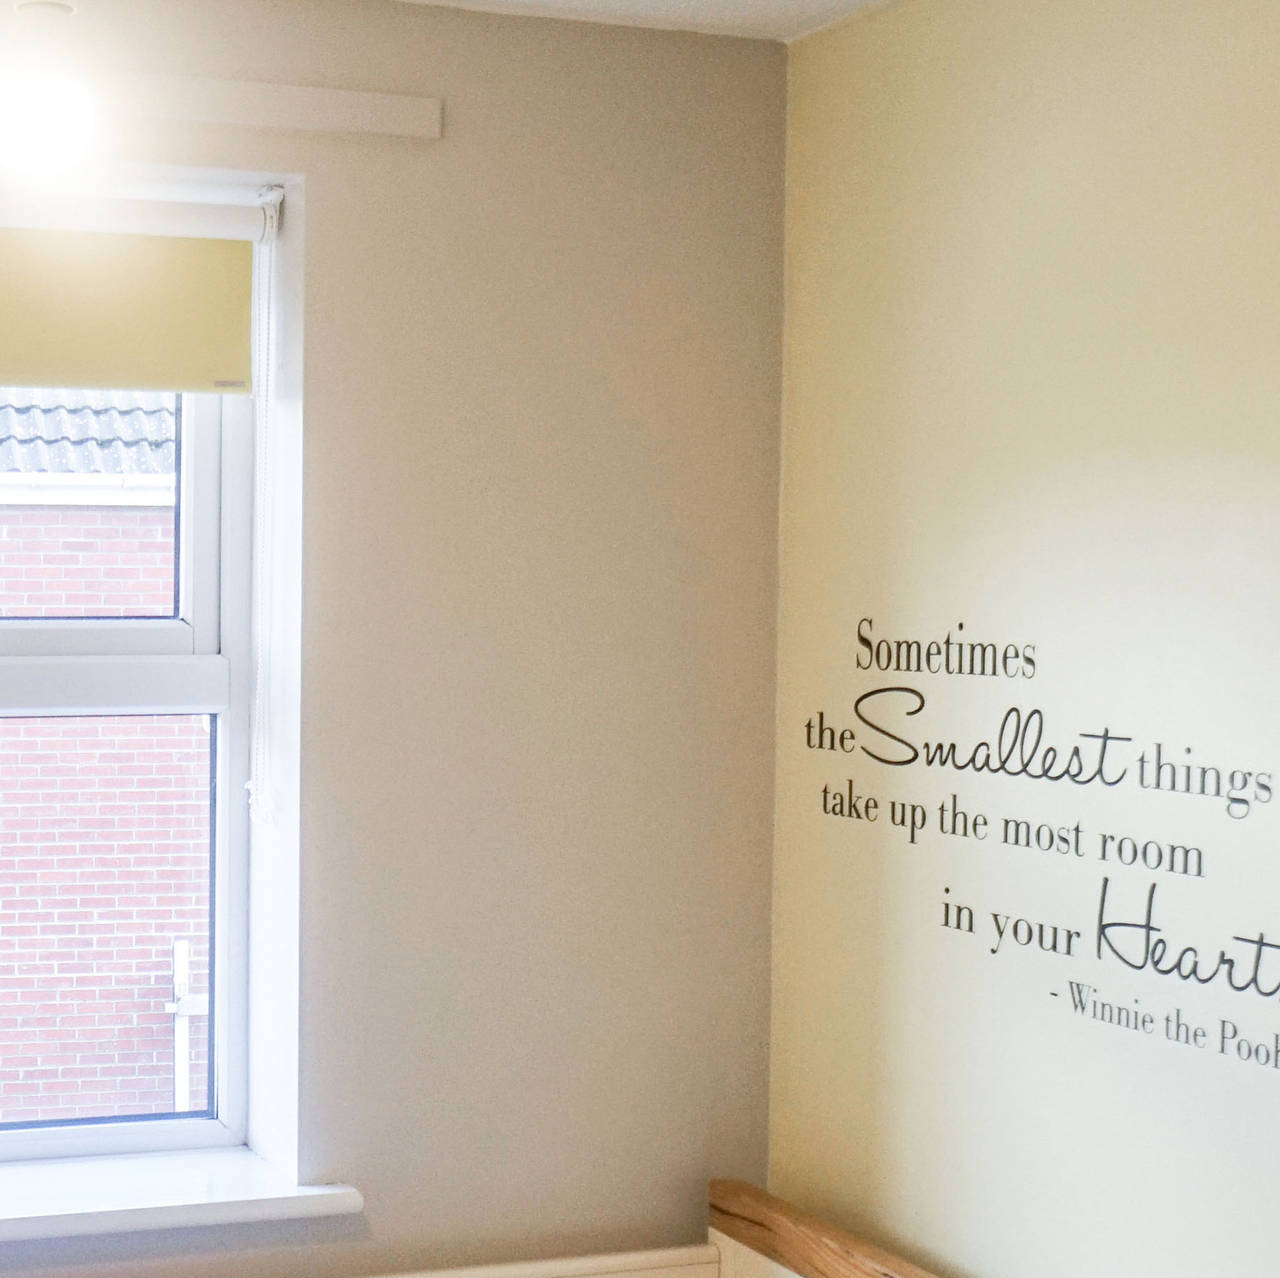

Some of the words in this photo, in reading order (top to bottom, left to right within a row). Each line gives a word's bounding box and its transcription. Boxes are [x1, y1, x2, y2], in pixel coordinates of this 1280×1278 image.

[855, 617, 1036, 680] Sometimes
[804, 710, 856, 754] the
[853, 686, 1133, 788] Smallest
[1136, 742, 1273, 820] things
[821, 778, 879, 823] take
[889, 800, 927, 845] up
[937, 793, 989, 841] the
[1001, 817, 1085, 858] most
[1098, 833, 1206, 879] room
[940, 886, 976, 935] in
[989, 912, 1082, 957] your
[1067, 979, 1156, 1034] Winnie
[1163, 1008, 1209, 1050] the
